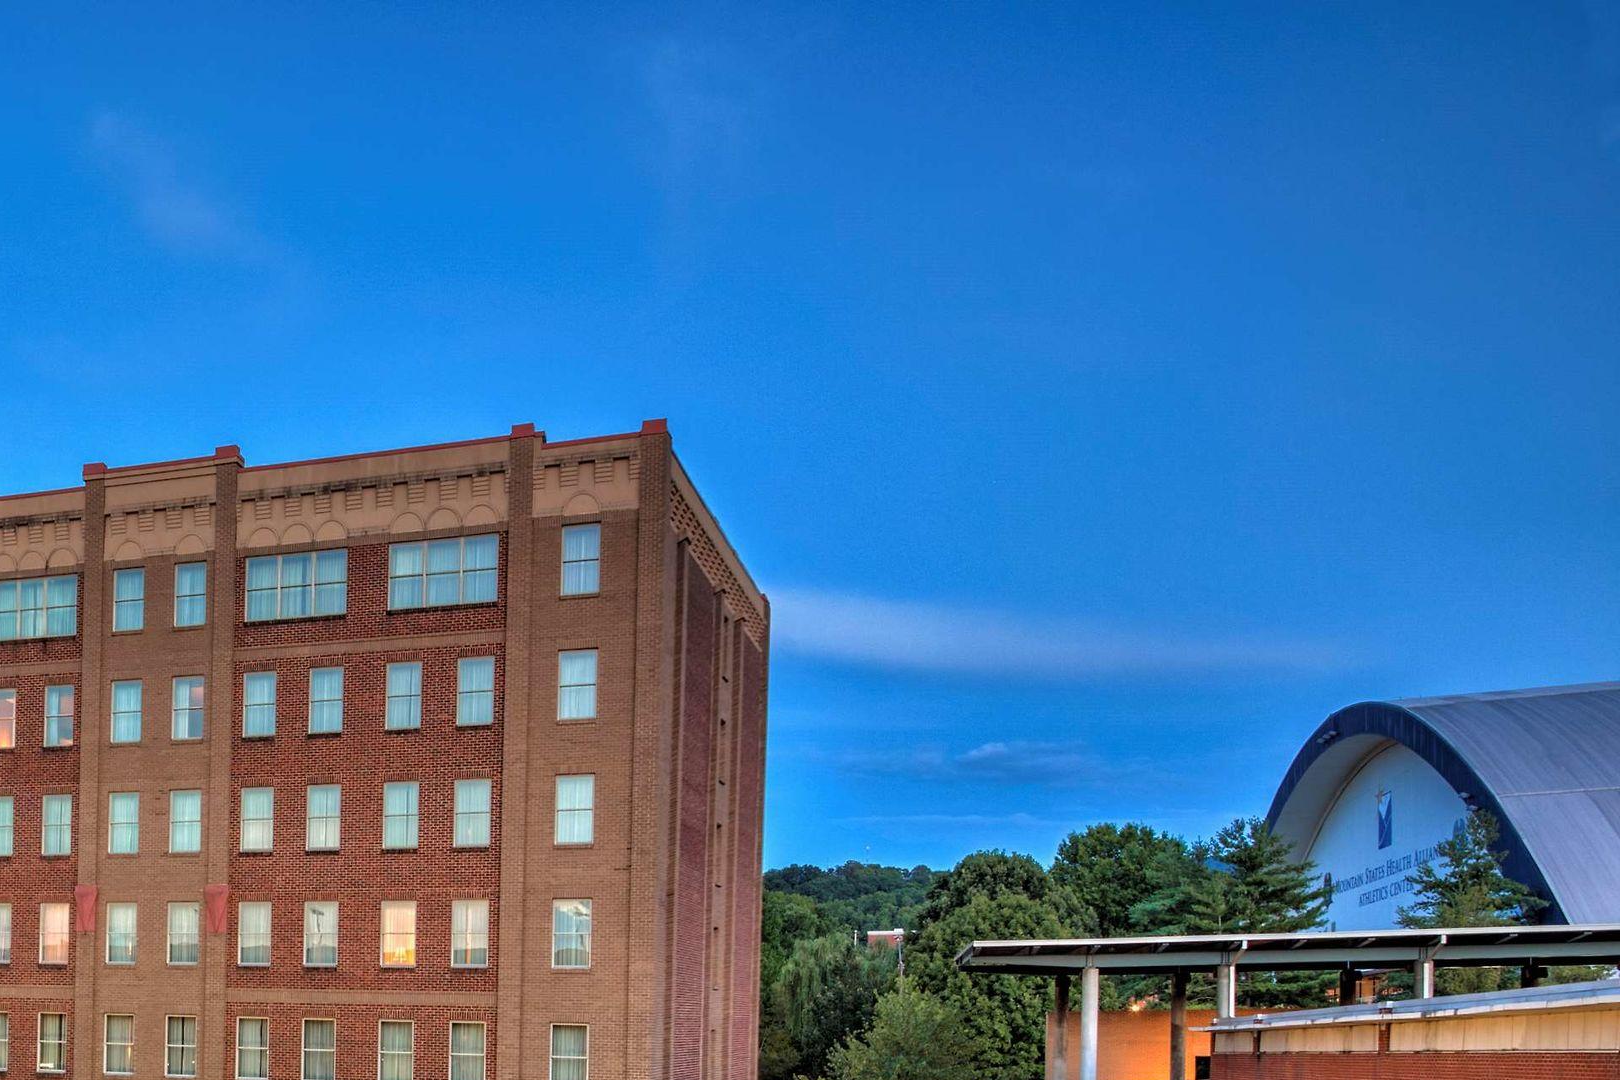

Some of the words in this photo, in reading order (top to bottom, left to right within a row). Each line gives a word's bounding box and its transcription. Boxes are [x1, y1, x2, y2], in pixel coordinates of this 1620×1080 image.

[1365, 865, 1385, 884] STATES
[1386, 854, 1412, 876] HEALTH
[1359, 885, 1388, 906] ATHLETICS
[1389, 879, 1415, 897] CENTER
